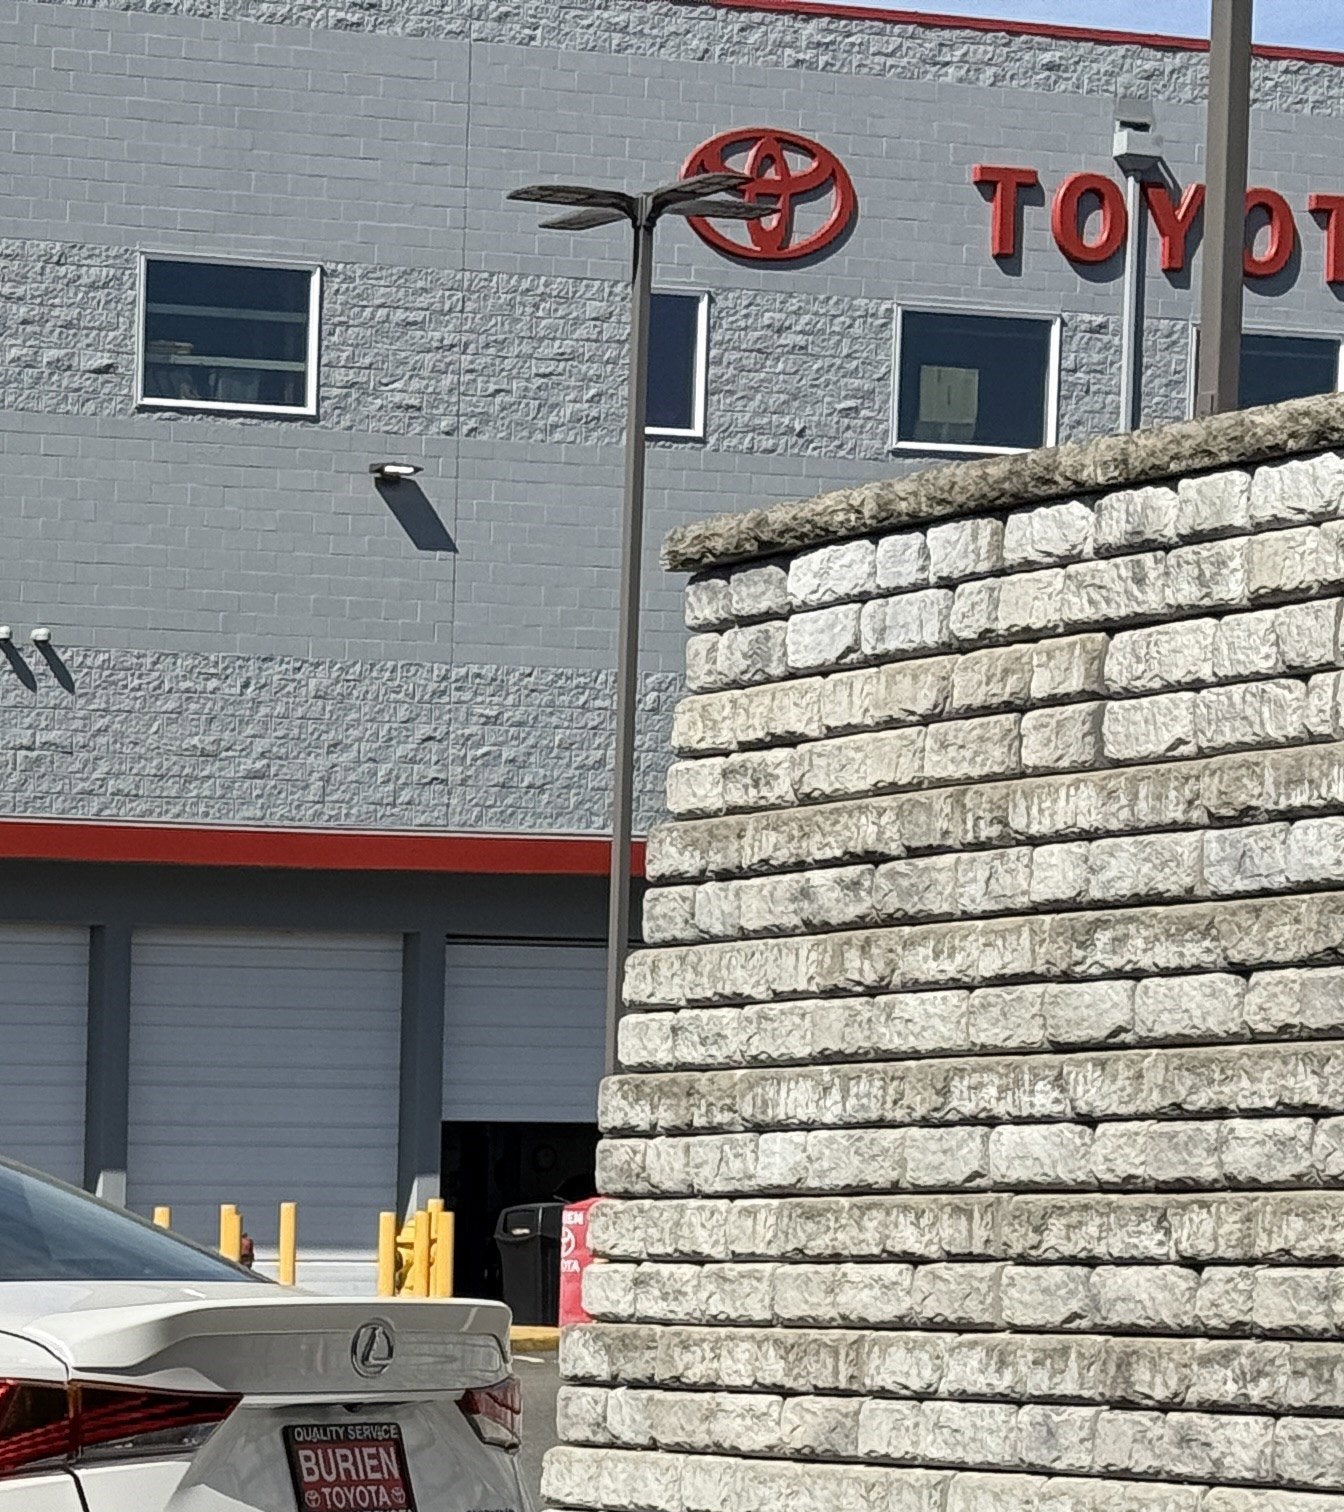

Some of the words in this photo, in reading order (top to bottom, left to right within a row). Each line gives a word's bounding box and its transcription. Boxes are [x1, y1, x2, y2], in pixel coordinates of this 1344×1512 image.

[294, 1426, 345, 1441] QUALITY
[347, 1424, 399, 1440] SERVICE
[298, 1446, 401, 1483] BURIEN
[321, 1484, 392, 1509] TOYOTA
